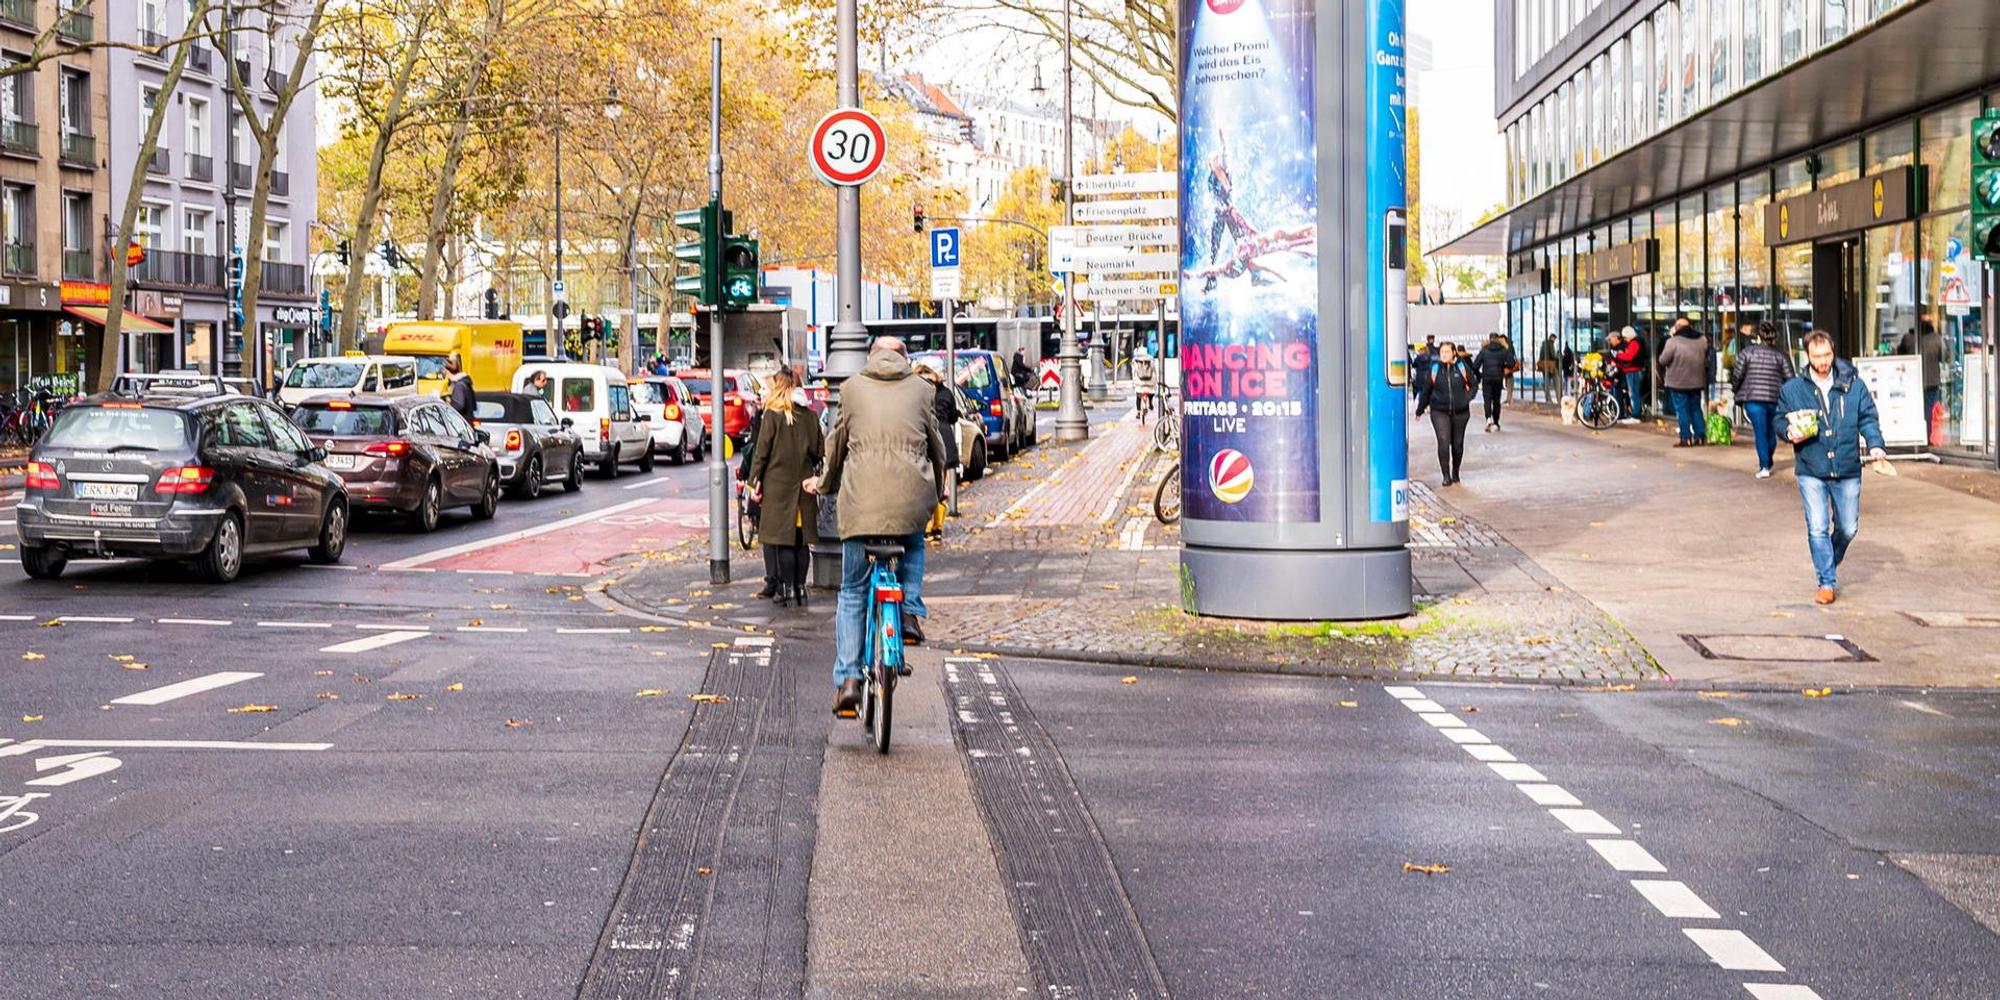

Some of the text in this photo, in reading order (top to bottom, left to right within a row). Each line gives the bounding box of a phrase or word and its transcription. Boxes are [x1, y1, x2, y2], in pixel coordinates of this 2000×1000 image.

[1193, 40, 1270, 57] Welcher Promi
[1197, 55, 1262, 70] wird das Eis
[1376, 49, 1399, 66] Ganz
[1195, 68, 1266, 85] beherrschen?
[827, 129, 870, 163] 30
[1085, 180, 1136, 191] Ebertplatz
[1086, 206, 1147, 217] Friesenplatz
[1086, 232, 1164, 242] Deutzer Brücke
[937, 233, 953, 264] P
[1086, 260, 1135, 270] Neumarkt
[40, 288, 46, 307] 5
[1087, 286, 1133, 296] Aachener
[1139, 285, 1156, 295] Str.
[1181, 342, 1311, 371] DANCING
[1188, 370, 1288, 398] ON ICE
[1184, 401, 1302, 416] FREITAGS 20:15
[1213, 418, 1247, 433] LIVE
[83, 482, 136, 497] ERK XF 49
[90, 503, 109, 513] Fred
